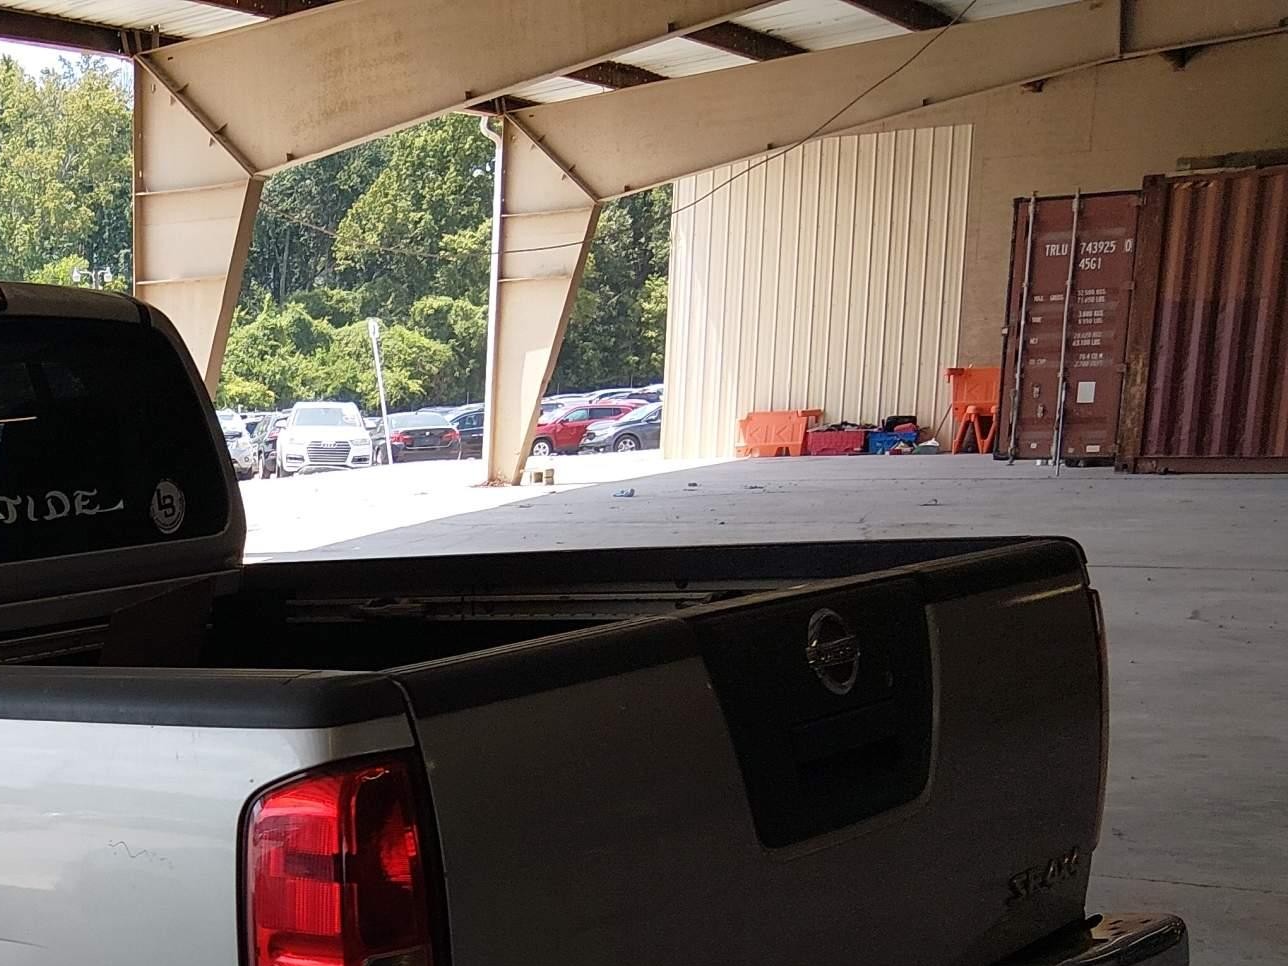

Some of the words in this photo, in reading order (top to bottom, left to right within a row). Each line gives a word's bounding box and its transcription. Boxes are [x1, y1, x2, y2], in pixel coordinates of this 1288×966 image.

[1045, 244, 1069, 257] TRLU
[1079, 241, 1116, 255] 743925
[1078, 257, 1102, 271] 45G1
